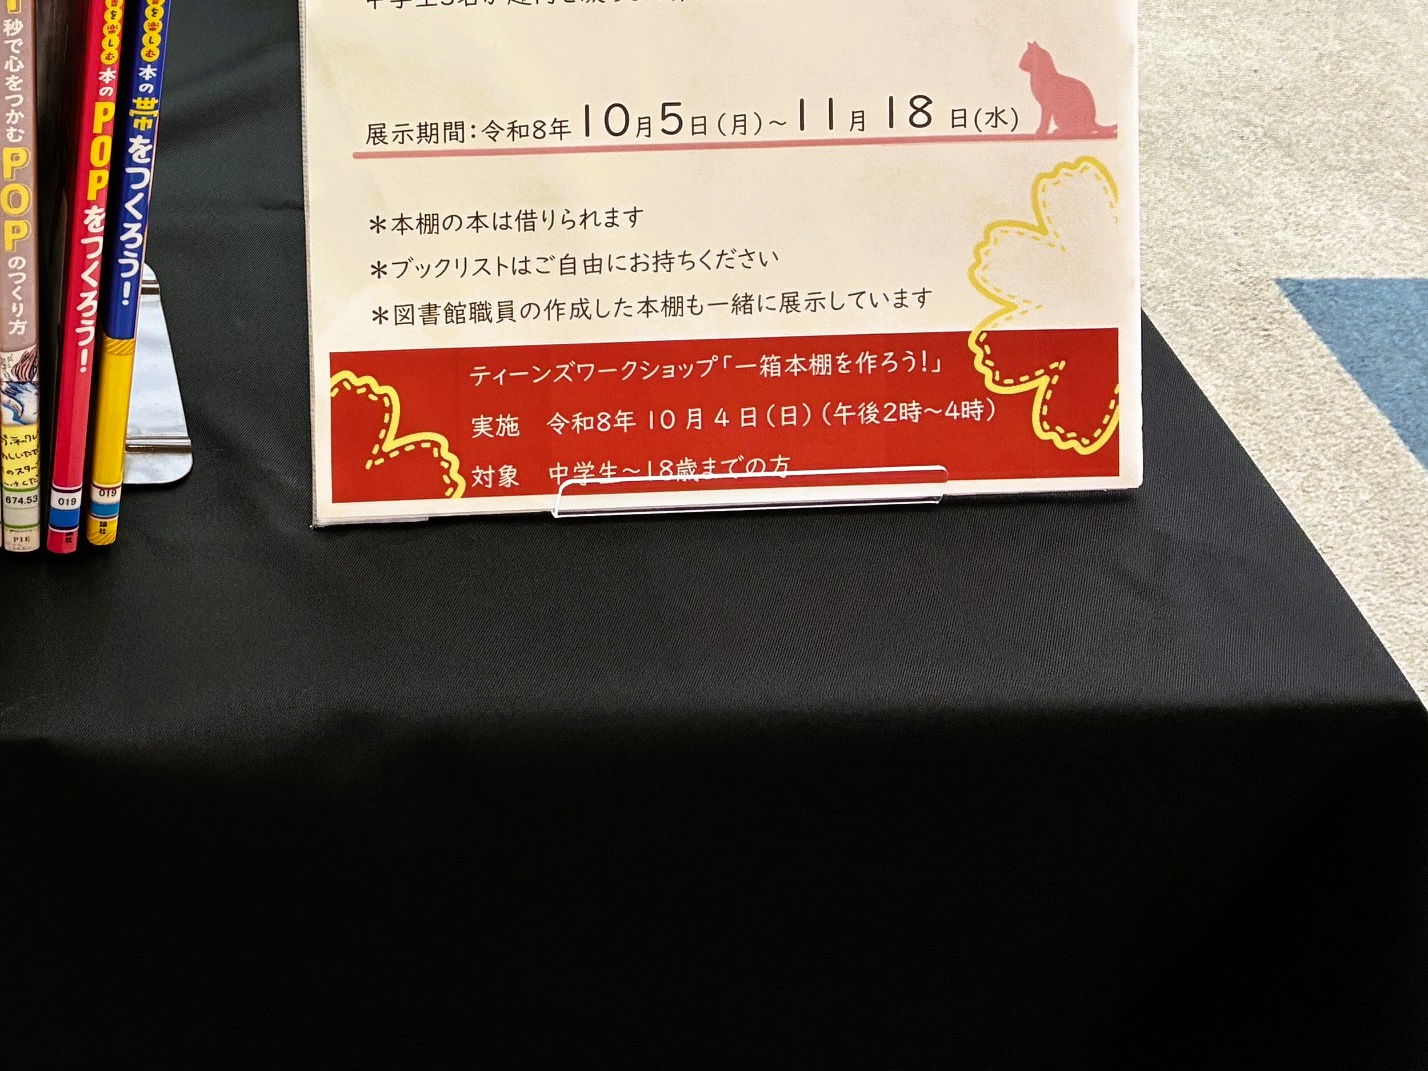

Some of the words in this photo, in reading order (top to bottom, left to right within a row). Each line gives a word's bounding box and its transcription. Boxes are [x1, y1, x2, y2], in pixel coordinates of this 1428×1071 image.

[471, 413, 521, 438] 実施
[471, 464, 521, 488] 対象
[98, 489, 117, 498] 019
[4, 494, 39, 506] 674.53
[57, 497, 77, 506] 019
